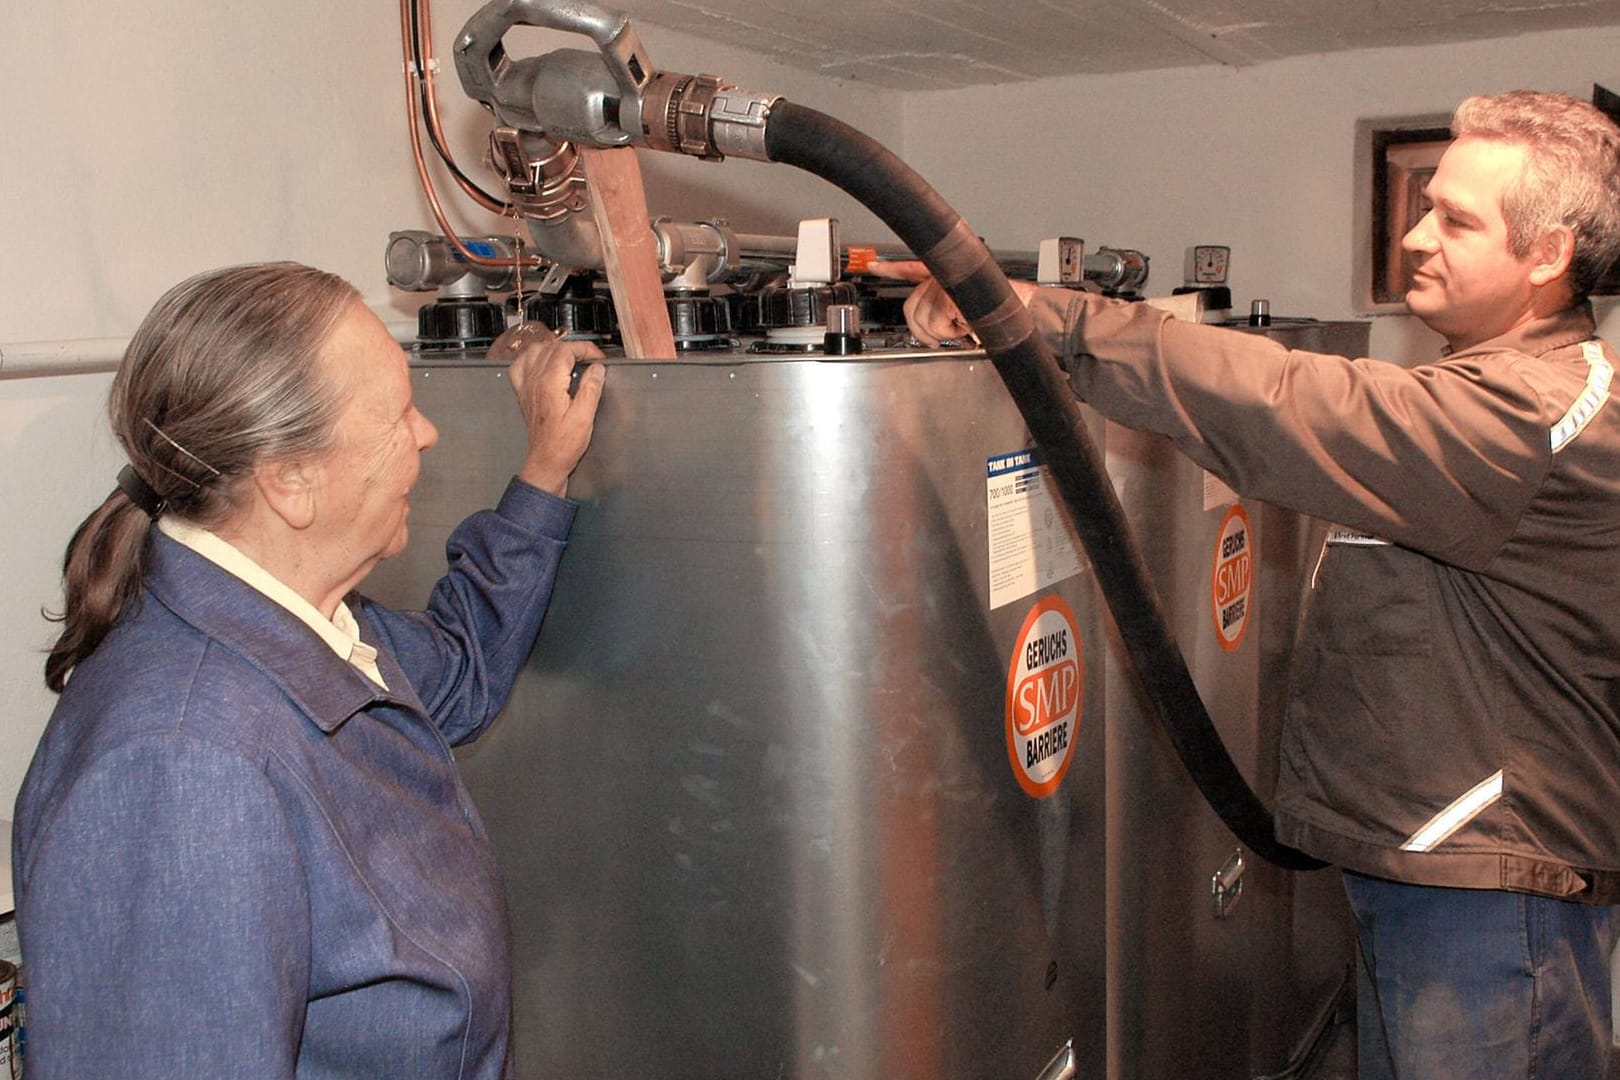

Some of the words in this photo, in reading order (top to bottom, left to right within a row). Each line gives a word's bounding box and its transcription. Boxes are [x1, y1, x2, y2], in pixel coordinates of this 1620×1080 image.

[988, 460, 1005, 472] TANK
[1223, 529, 1244, 558] GERUCHS
[1219, 556, 1249, 602] SMP
[1223, 598, 1244, 630] BARRIERE
[1026, 629, 1067, 670] GERUCHS
[1019, 667, 1075, 732] SMP
[1026, 722, 1068, 769] BARRIERE
